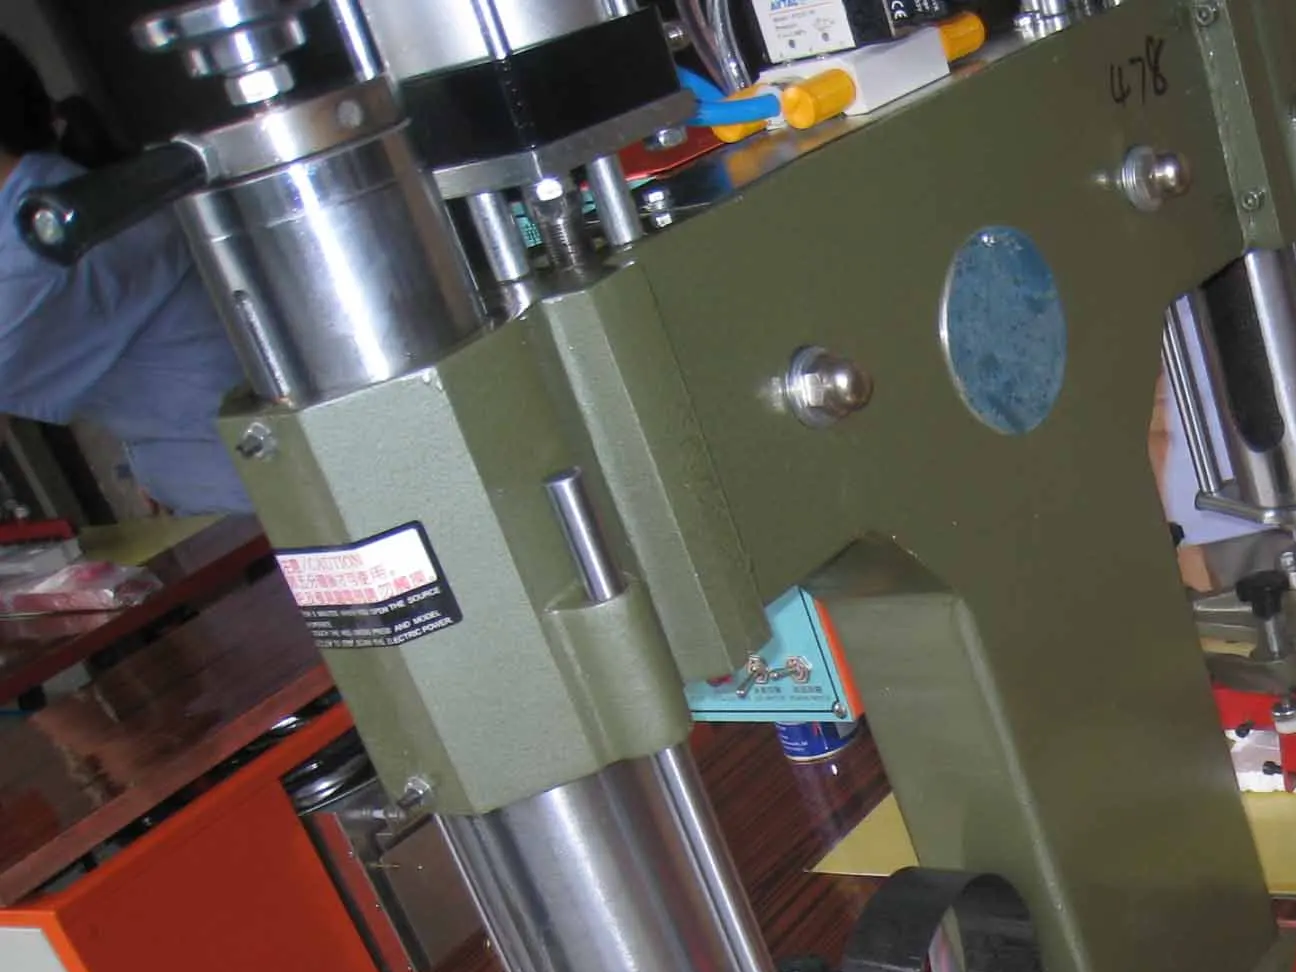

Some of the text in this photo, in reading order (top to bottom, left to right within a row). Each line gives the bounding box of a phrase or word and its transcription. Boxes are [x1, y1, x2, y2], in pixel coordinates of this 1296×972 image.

[1110, 35, 1168, 107] 478
[407, 586, 441, 605] SOURCE
[394, 621, 411, 632] AND
[422, 616, 454, 633] POWER
